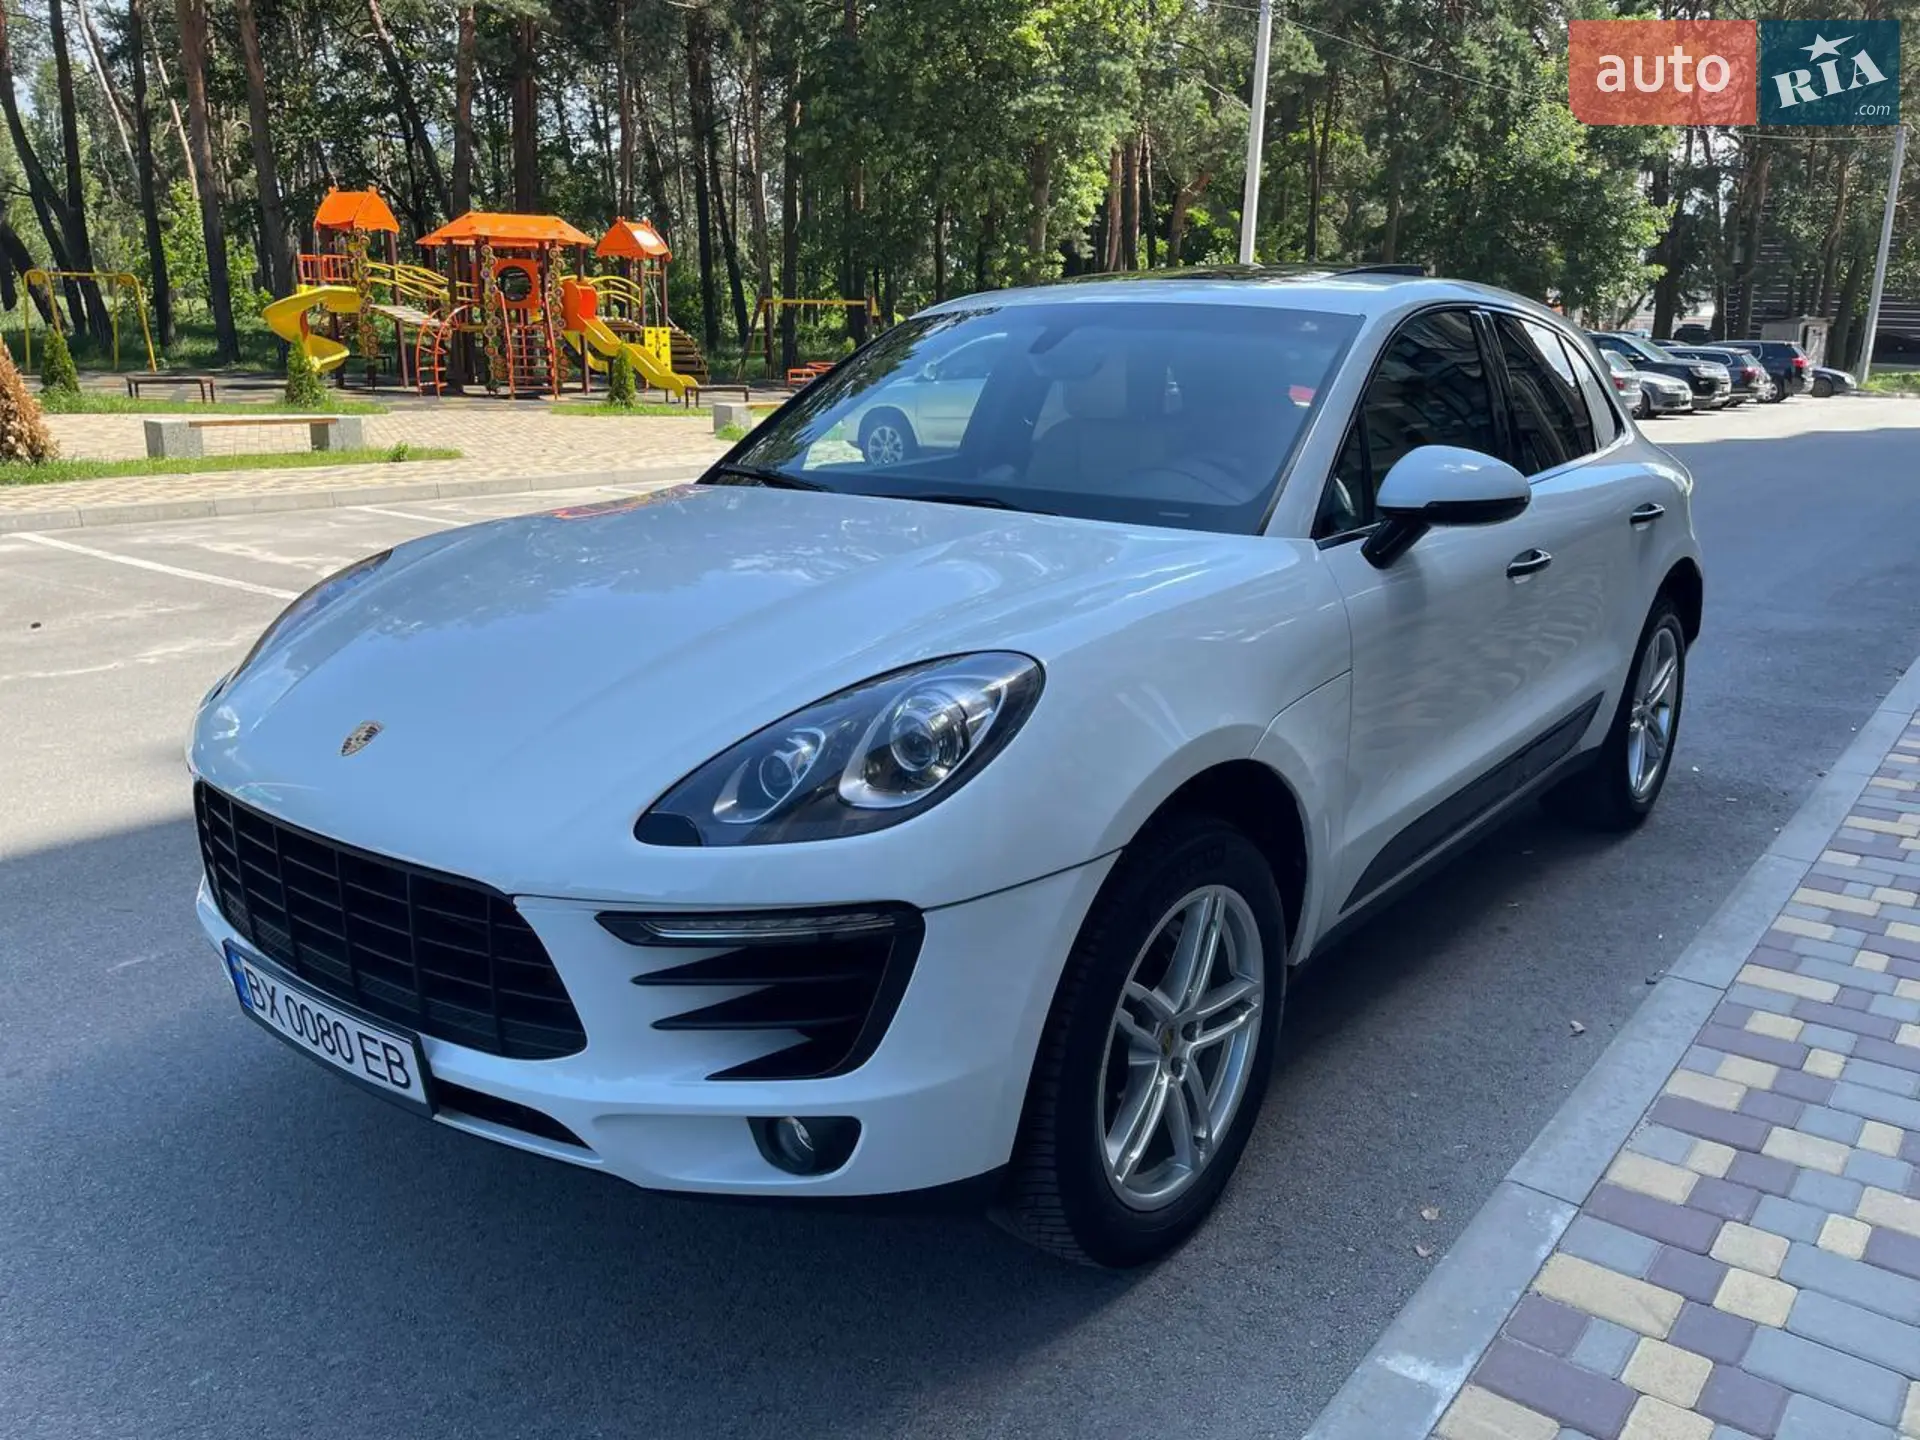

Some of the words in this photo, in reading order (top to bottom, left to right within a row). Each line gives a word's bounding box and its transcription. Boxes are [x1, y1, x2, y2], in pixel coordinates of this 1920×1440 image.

[244, 966, 286, 1028] BX
[284, 994, 354, 1065] 0080
[357, 1030, 411, 1090] EB
